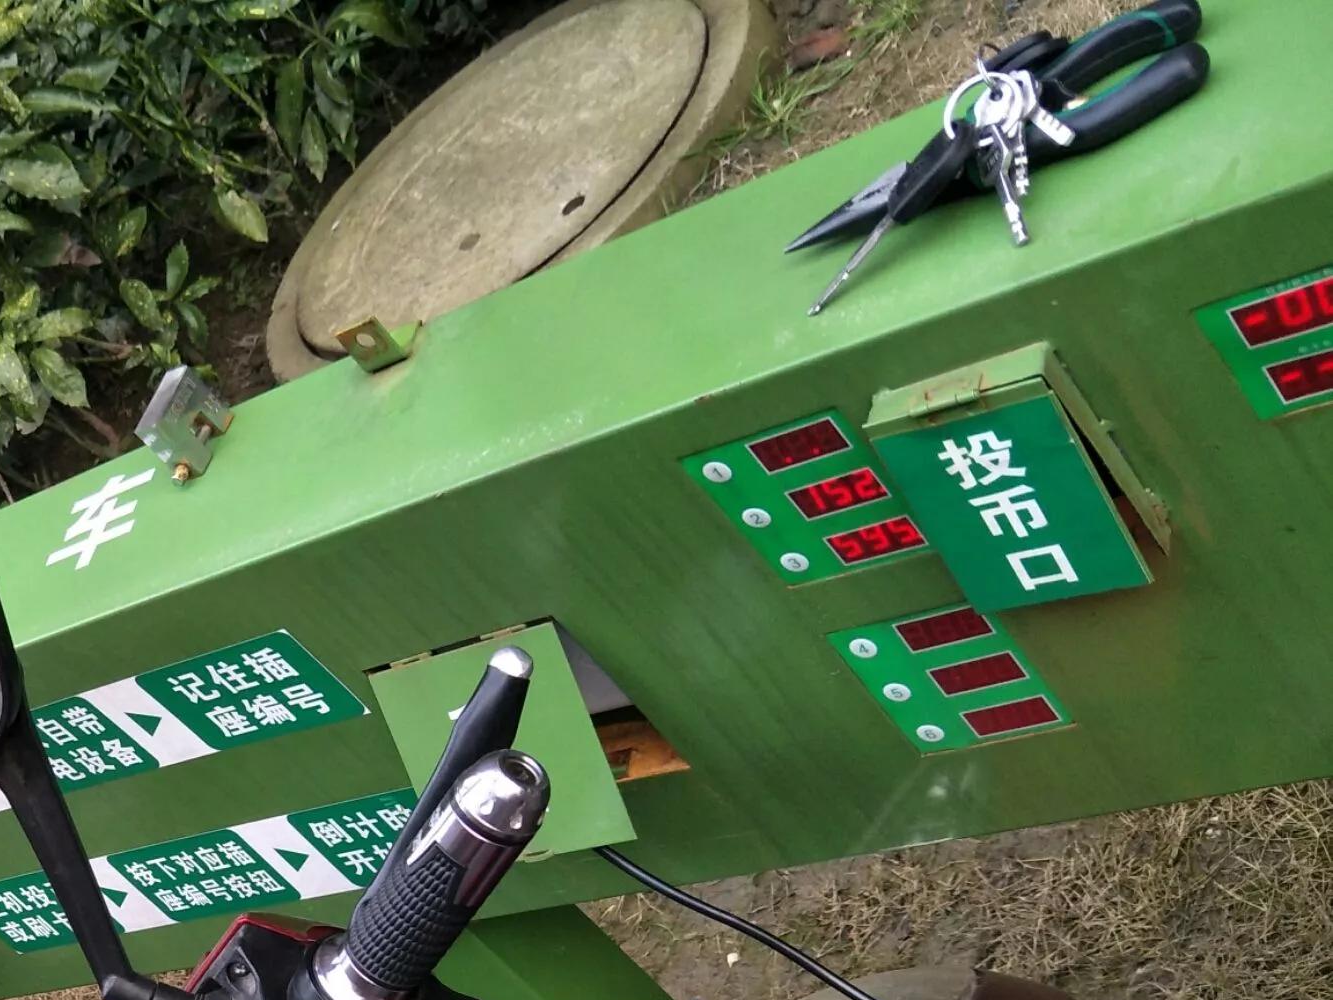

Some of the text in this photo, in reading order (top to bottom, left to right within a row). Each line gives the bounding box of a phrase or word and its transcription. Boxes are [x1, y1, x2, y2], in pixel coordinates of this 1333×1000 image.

[937, 430, 1079, 591] 投币口
[167, 646, 300, 705] 记住插
[35, 704, 107, 749] 自带
[205, 683, 331, 738] 座编号
[124, 840, 257, 888] 按下对应插
[154, 868, 286, 913] 座编号按钮
